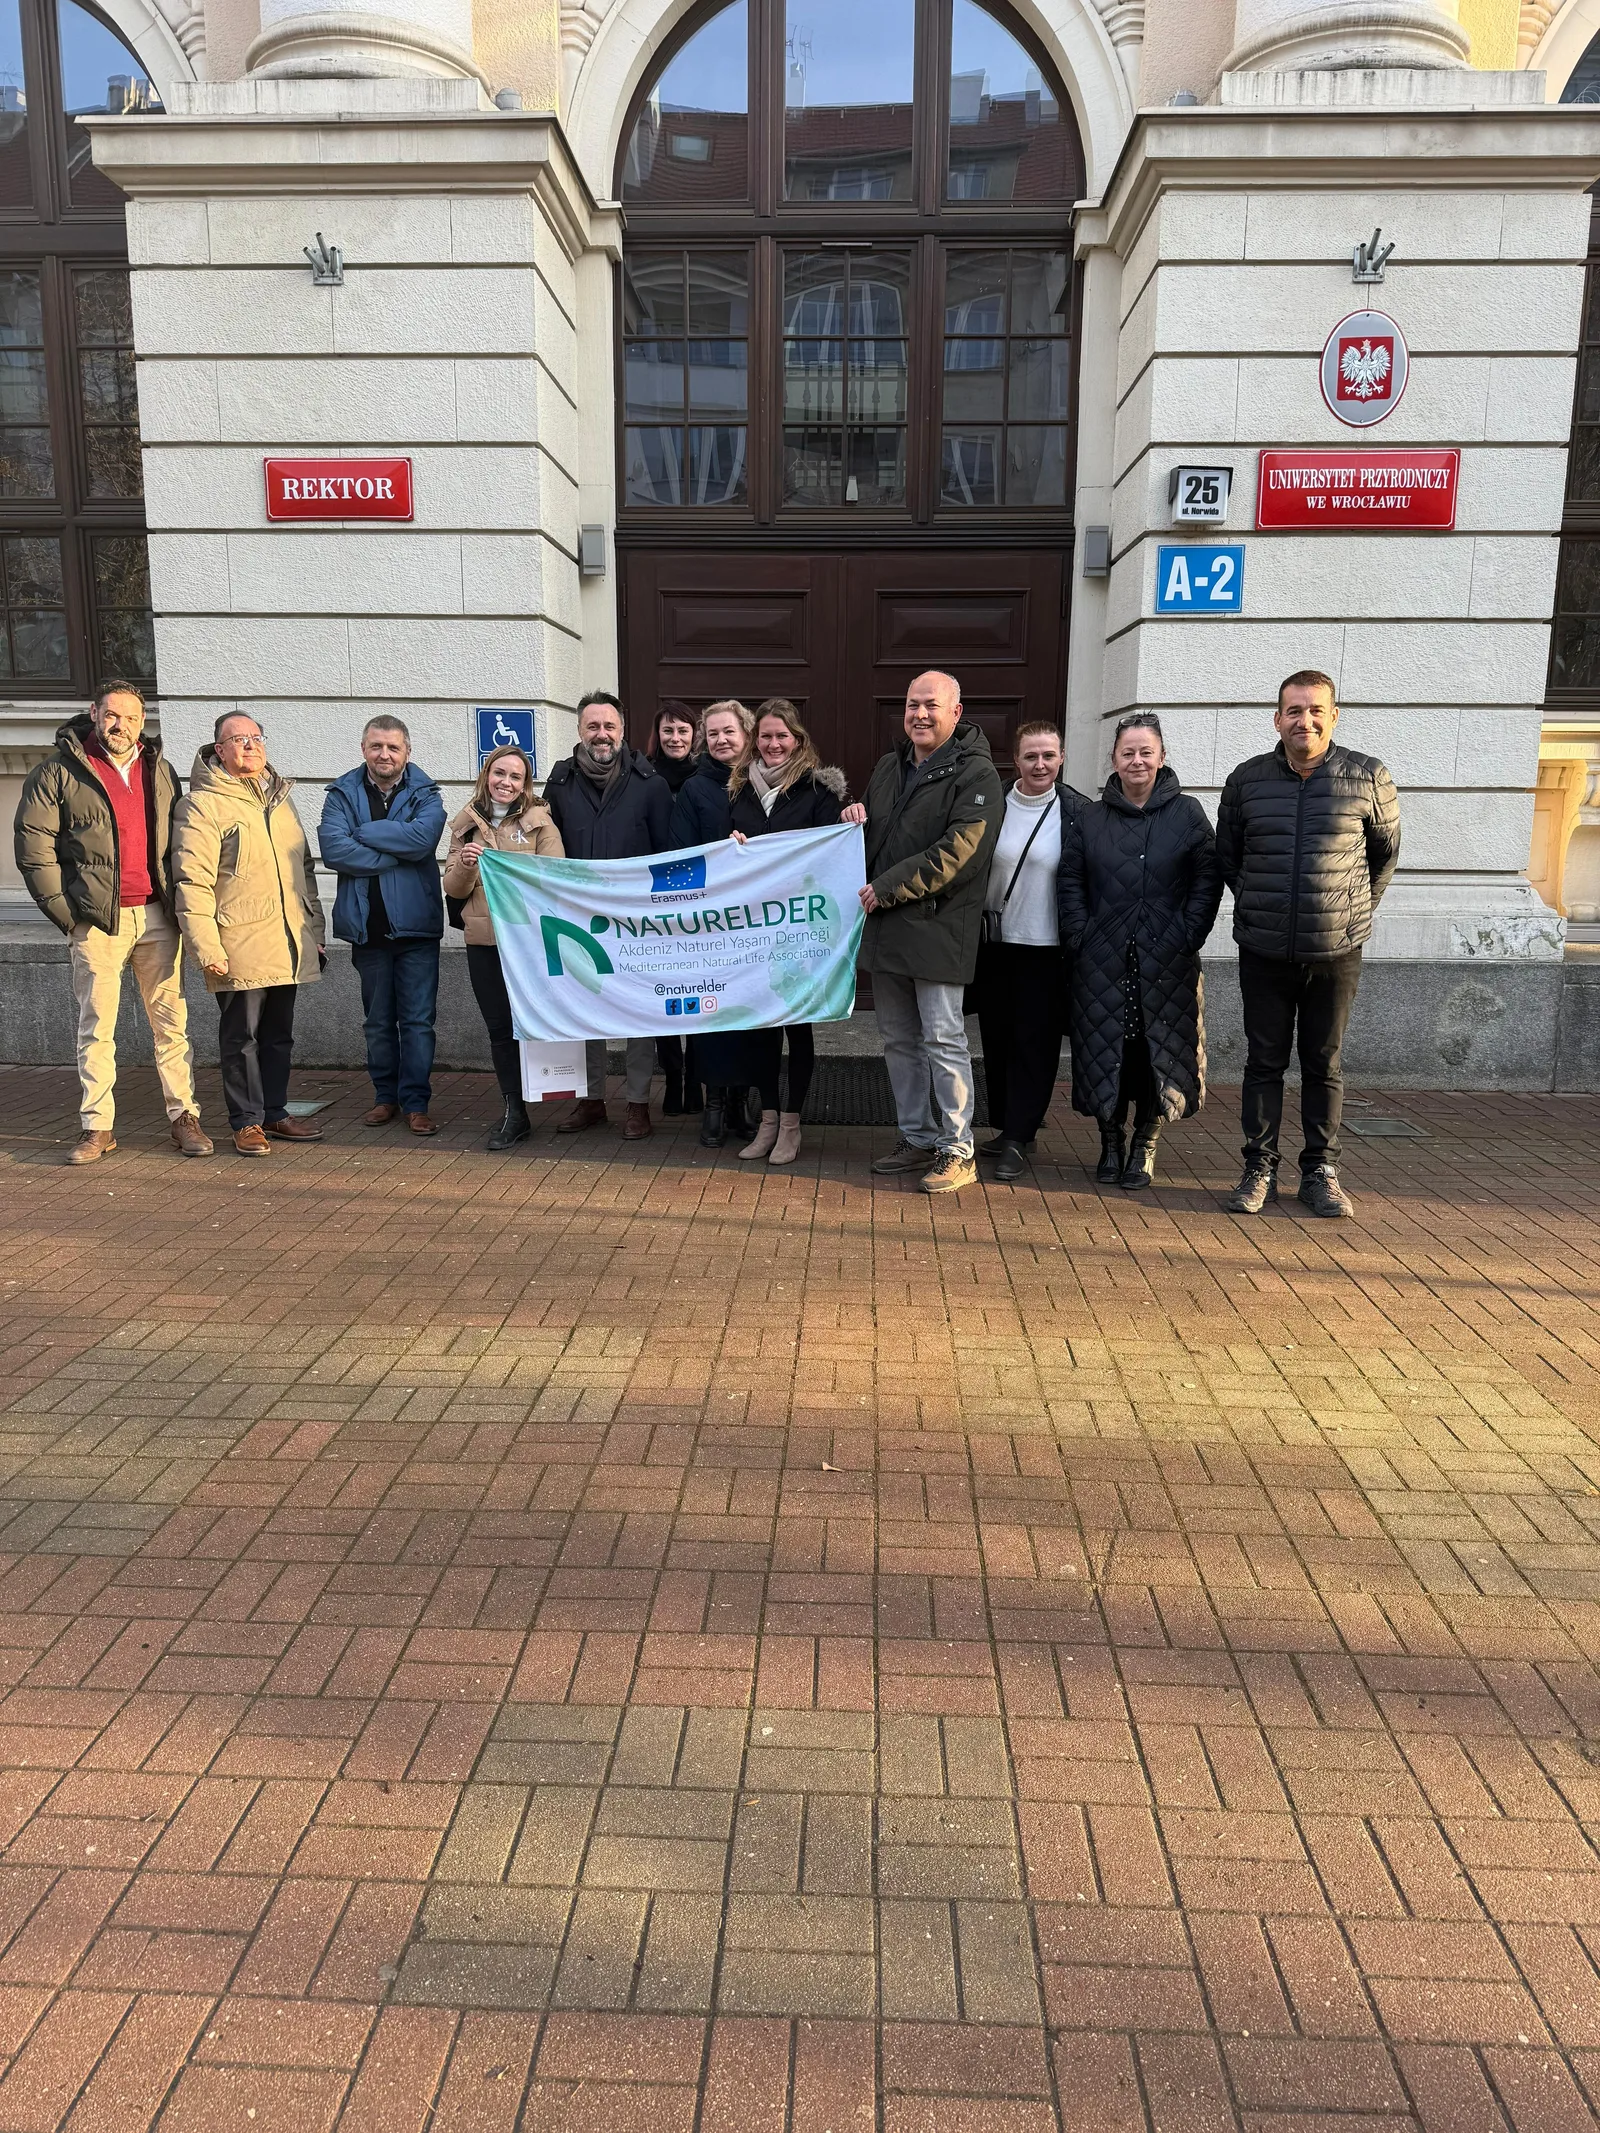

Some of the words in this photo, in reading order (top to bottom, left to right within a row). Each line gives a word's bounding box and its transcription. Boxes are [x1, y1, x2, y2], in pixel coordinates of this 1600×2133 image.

[281, 477, 395, 500] REKTOR
[1185, 475, 1220, 504] 25
[1269, 468, 1356, 489] UNIWERSYTET
[1359, 468, 1450, 489] PRZYRODNICZY
[1182, 507, 1190, 515] ul.
[1191, 507, 1219, 516] Norwida
[1306, 496, 1326, 509] WE
[1331, 495, 1411, 509] WROCŁAWIU
[1164, 555, 1235, 601] A-2
[650, 890, 708, 904] Erasmus+
[611, 894, 829, 938] NATURELDER
[618, 942, 672, 957] Akdeniz
[676, 937, 726, 953] Naturel
[729, 934, 771, 949] Yaşam
[776, 926, 830, 944] Derneği
[619, 959, 699, 973] Mediterranean
[702, 955, 742, 967] Natural
[745, 953, 765, 965] Life
[768, 946, 831, 962] Association
[654, 978, 727, 996] @naturelder
